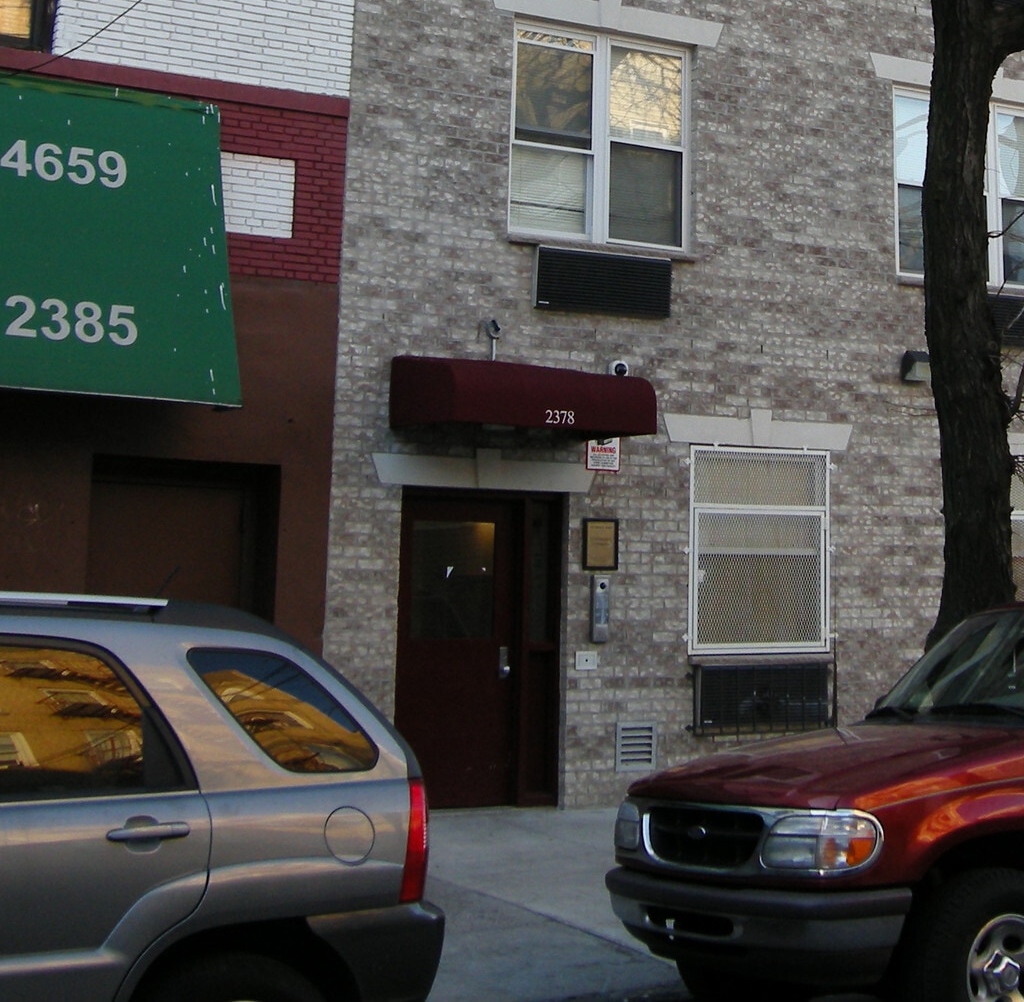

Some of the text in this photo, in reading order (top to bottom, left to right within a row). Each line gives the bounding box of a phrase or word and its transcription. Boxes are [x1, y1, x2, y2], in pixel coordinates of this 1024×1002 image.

[0, 139, 128, 188] 4659
[5, 294, 138, 346] 2385
[545, 409, 575, 425] 2378
[590, 445, 616, 454] WARNING
